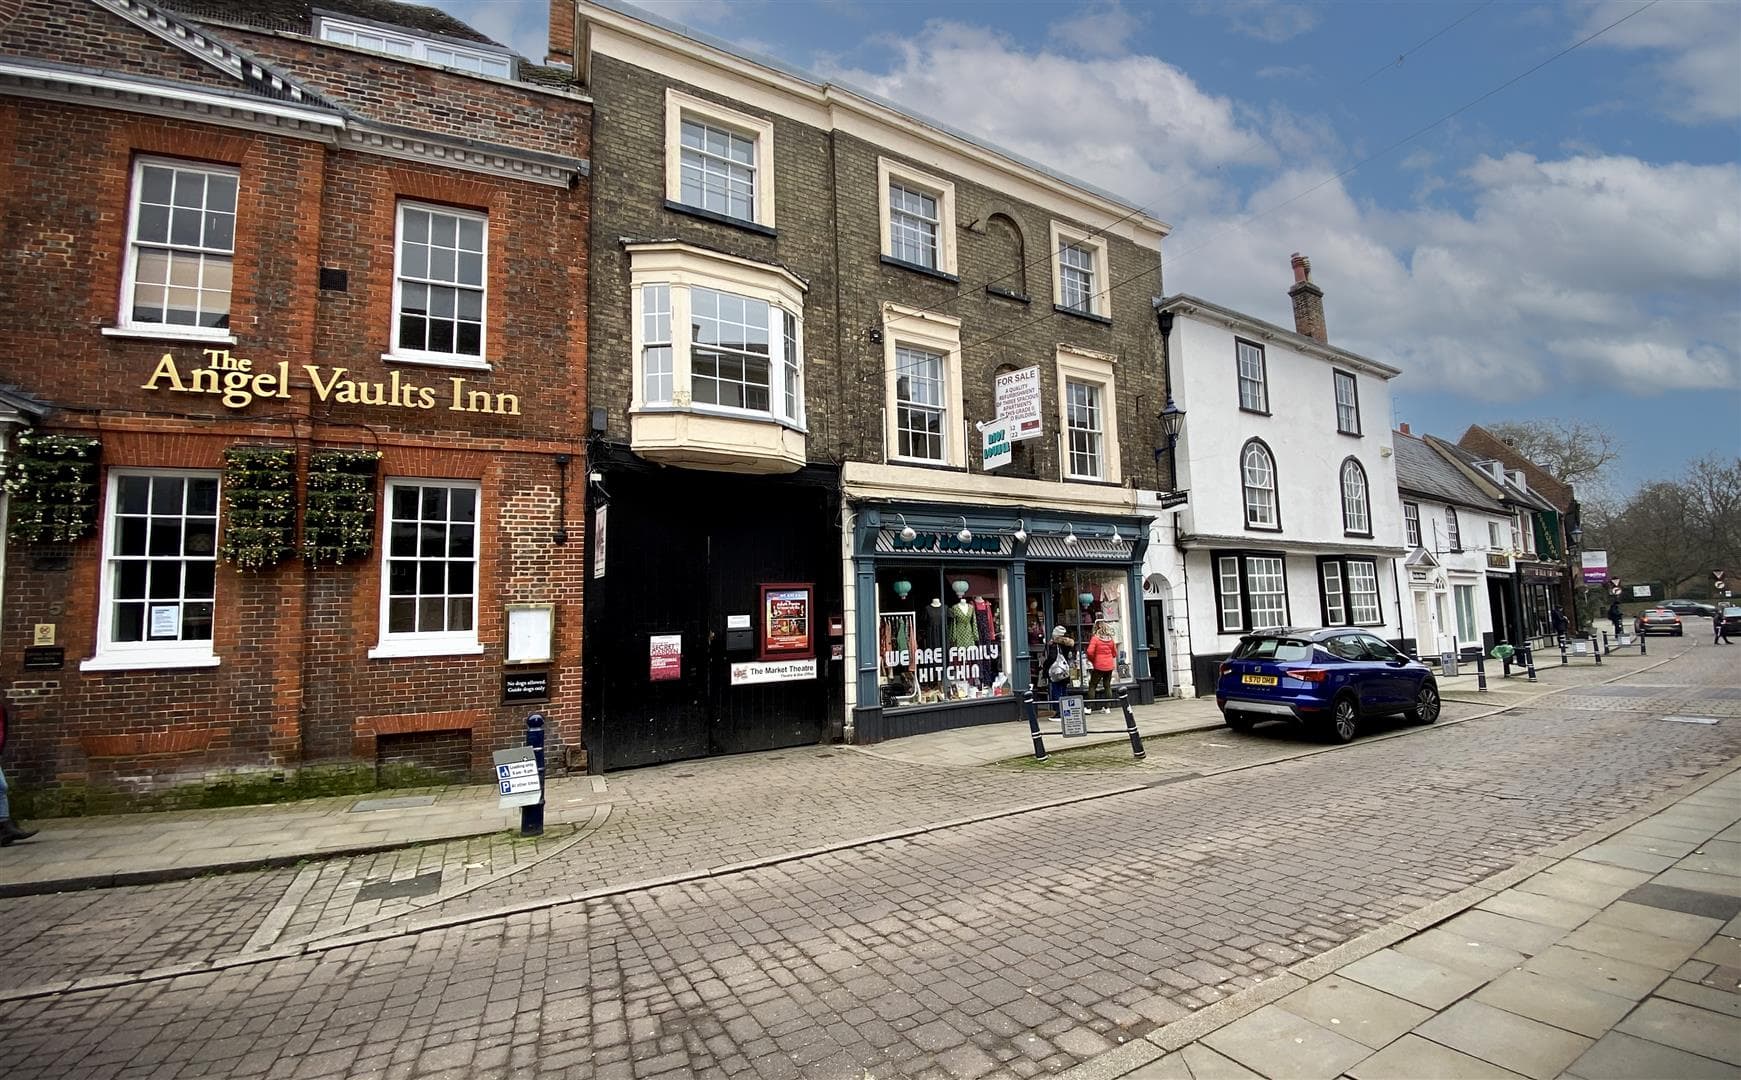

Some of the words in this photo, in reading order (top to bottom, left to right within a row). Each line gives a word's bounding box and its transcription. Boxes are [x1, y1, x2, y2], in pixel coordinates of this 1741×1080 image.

[203, 348, 252, 373] The
[141, 353, 291, 408] Angel
[303, 365, 435, 409] Vaults
[448, 377, 521, 416] Inn
[997, 375, 1013, 387] FOR
[1014, 369, 1035, 382] SALE
[1009, 383, 1028, 392] QUALITY
[1003, 400, 1032, 411] APARTMENTS
[1015, 406, 1031, 414] GRADE
[1014, 411, 1037, 420] BUILDING
[885, 650, 909, 667] WE
[915, 648, 942, 664] ARE
[949, 644, 998, 662] FAMILY
[765, 661, 787, 674] Market
[789, 660, 814, 672] Theatre
